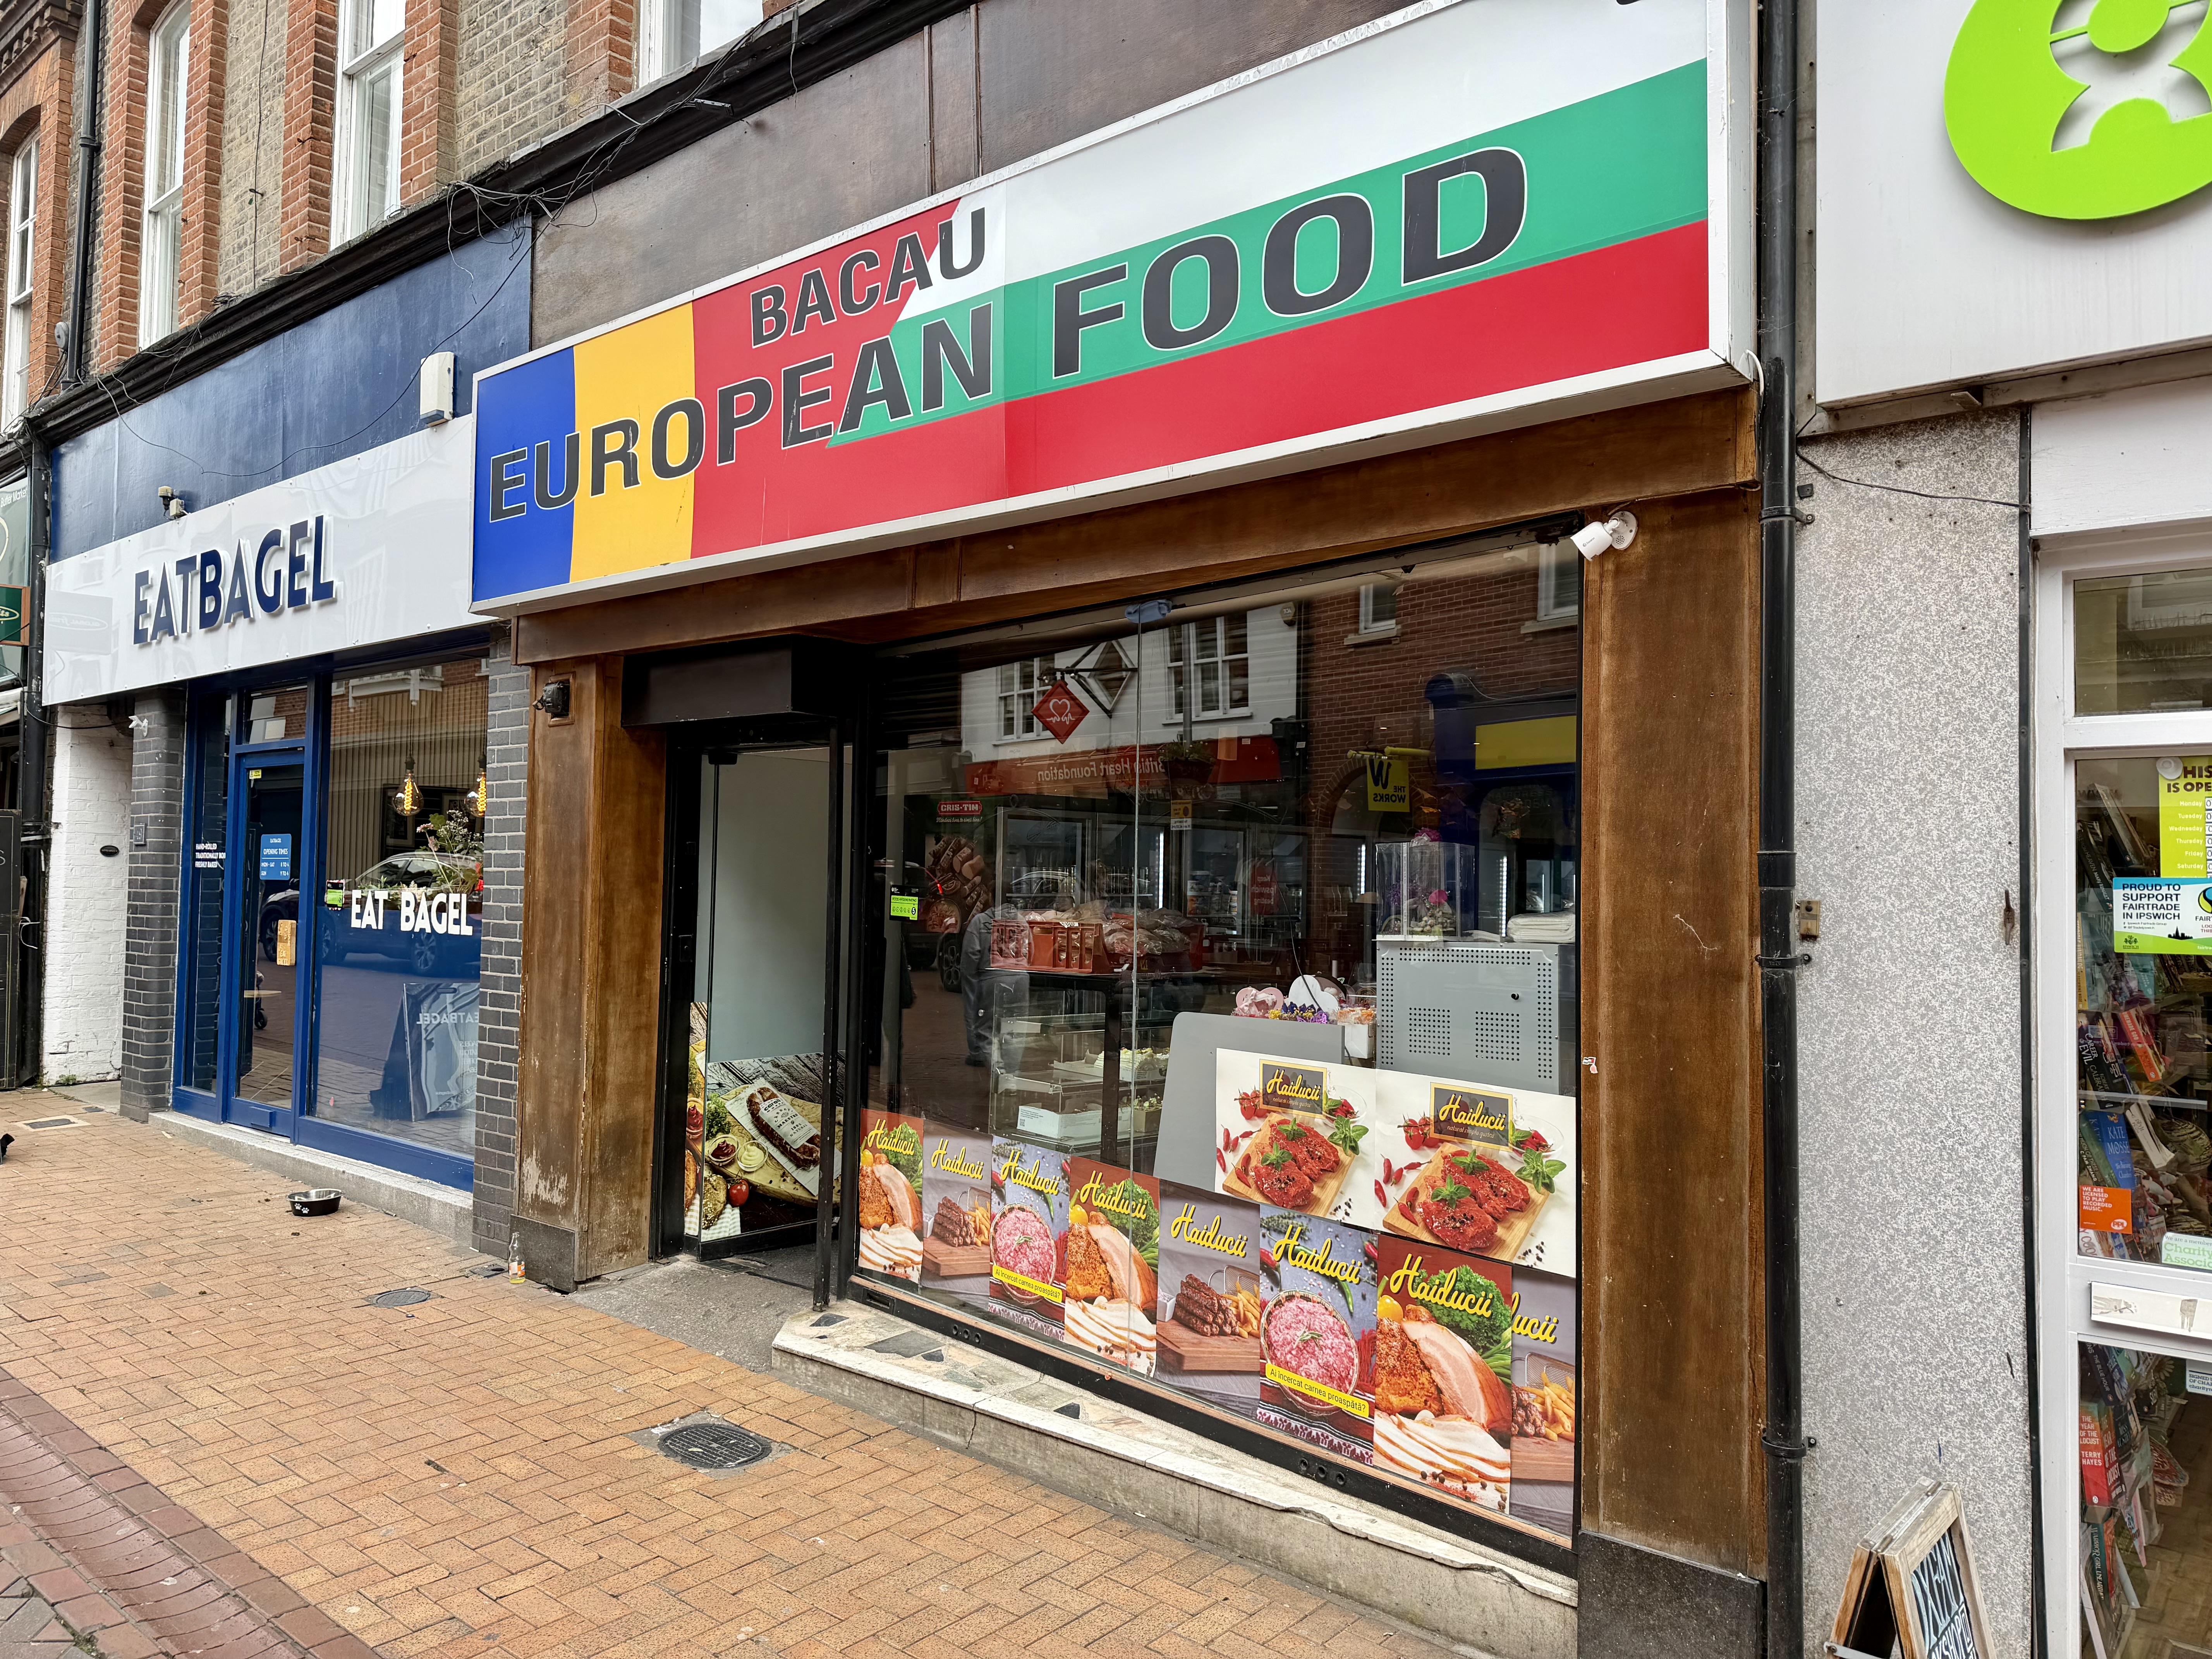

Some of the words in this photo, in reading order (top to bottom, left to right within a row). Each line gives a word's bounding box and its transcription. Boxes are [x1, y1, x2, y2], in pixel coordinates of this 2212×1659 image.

[750, 207, 985, 347] BACAU
[489, 302, 993, 523] EUROPEAN
[1052, 146, 1527, 379] FOOD
[133, 515, 338, 645] EATBAGEL
[2167, 783, 2180, 793] IS
[2178, 766, 2212, 778] HIS
[351, 890, 388, 929] EAT
[400, 891, 473, 936] BAGEL
[2123, 893, 2181, 901] SUPPORT
[2079, 1044, 2093, 1065] EVIL
[2085, 1033, 2098, 1060] CAREER
[1266, 1068, 1321, 1101] Haiducii
[1439, 1094, 1506, 1131] Haiducii
[867, 1119, 915, 1156] Haiducii
[2107, 1126, 2126, 1139] KATE
[2107, 1141, 2130, 1155] MOSSE
[931, 1138, 984, 1180] Haiducii
[1001, 1150, 1061, 1195] Haiducii
[2087, 1165, 2097, 1182] ZHANG
[1079, 1171, 1147, 1220] Haiducii
[1171, 1203, 1248, 1258] Haiducii
[1273, 1224, 1362, 1285] Haiducii
[2164, 1242, 2212, 1259] Charity
[1018, 1279, 1034, 1289] carnea
[1034, 1285, 1060, 1298] proaspătă?
[1390, 1253, 1494, 1317] Haiducii
[1271, 1369, 1277, 1377] Ai
[1278, 1372, 1303, 1388] încercat
[1305, 1383, 1326, 1397] carnea
[1328, 1392, 1366, 1412] proaspătă?
[2097, 1363, 2105, 1377] BLUE
[2101, 1377, 2110, 1391] HOUR
[2090, 1527, 2100, 1557] WARRIOR
